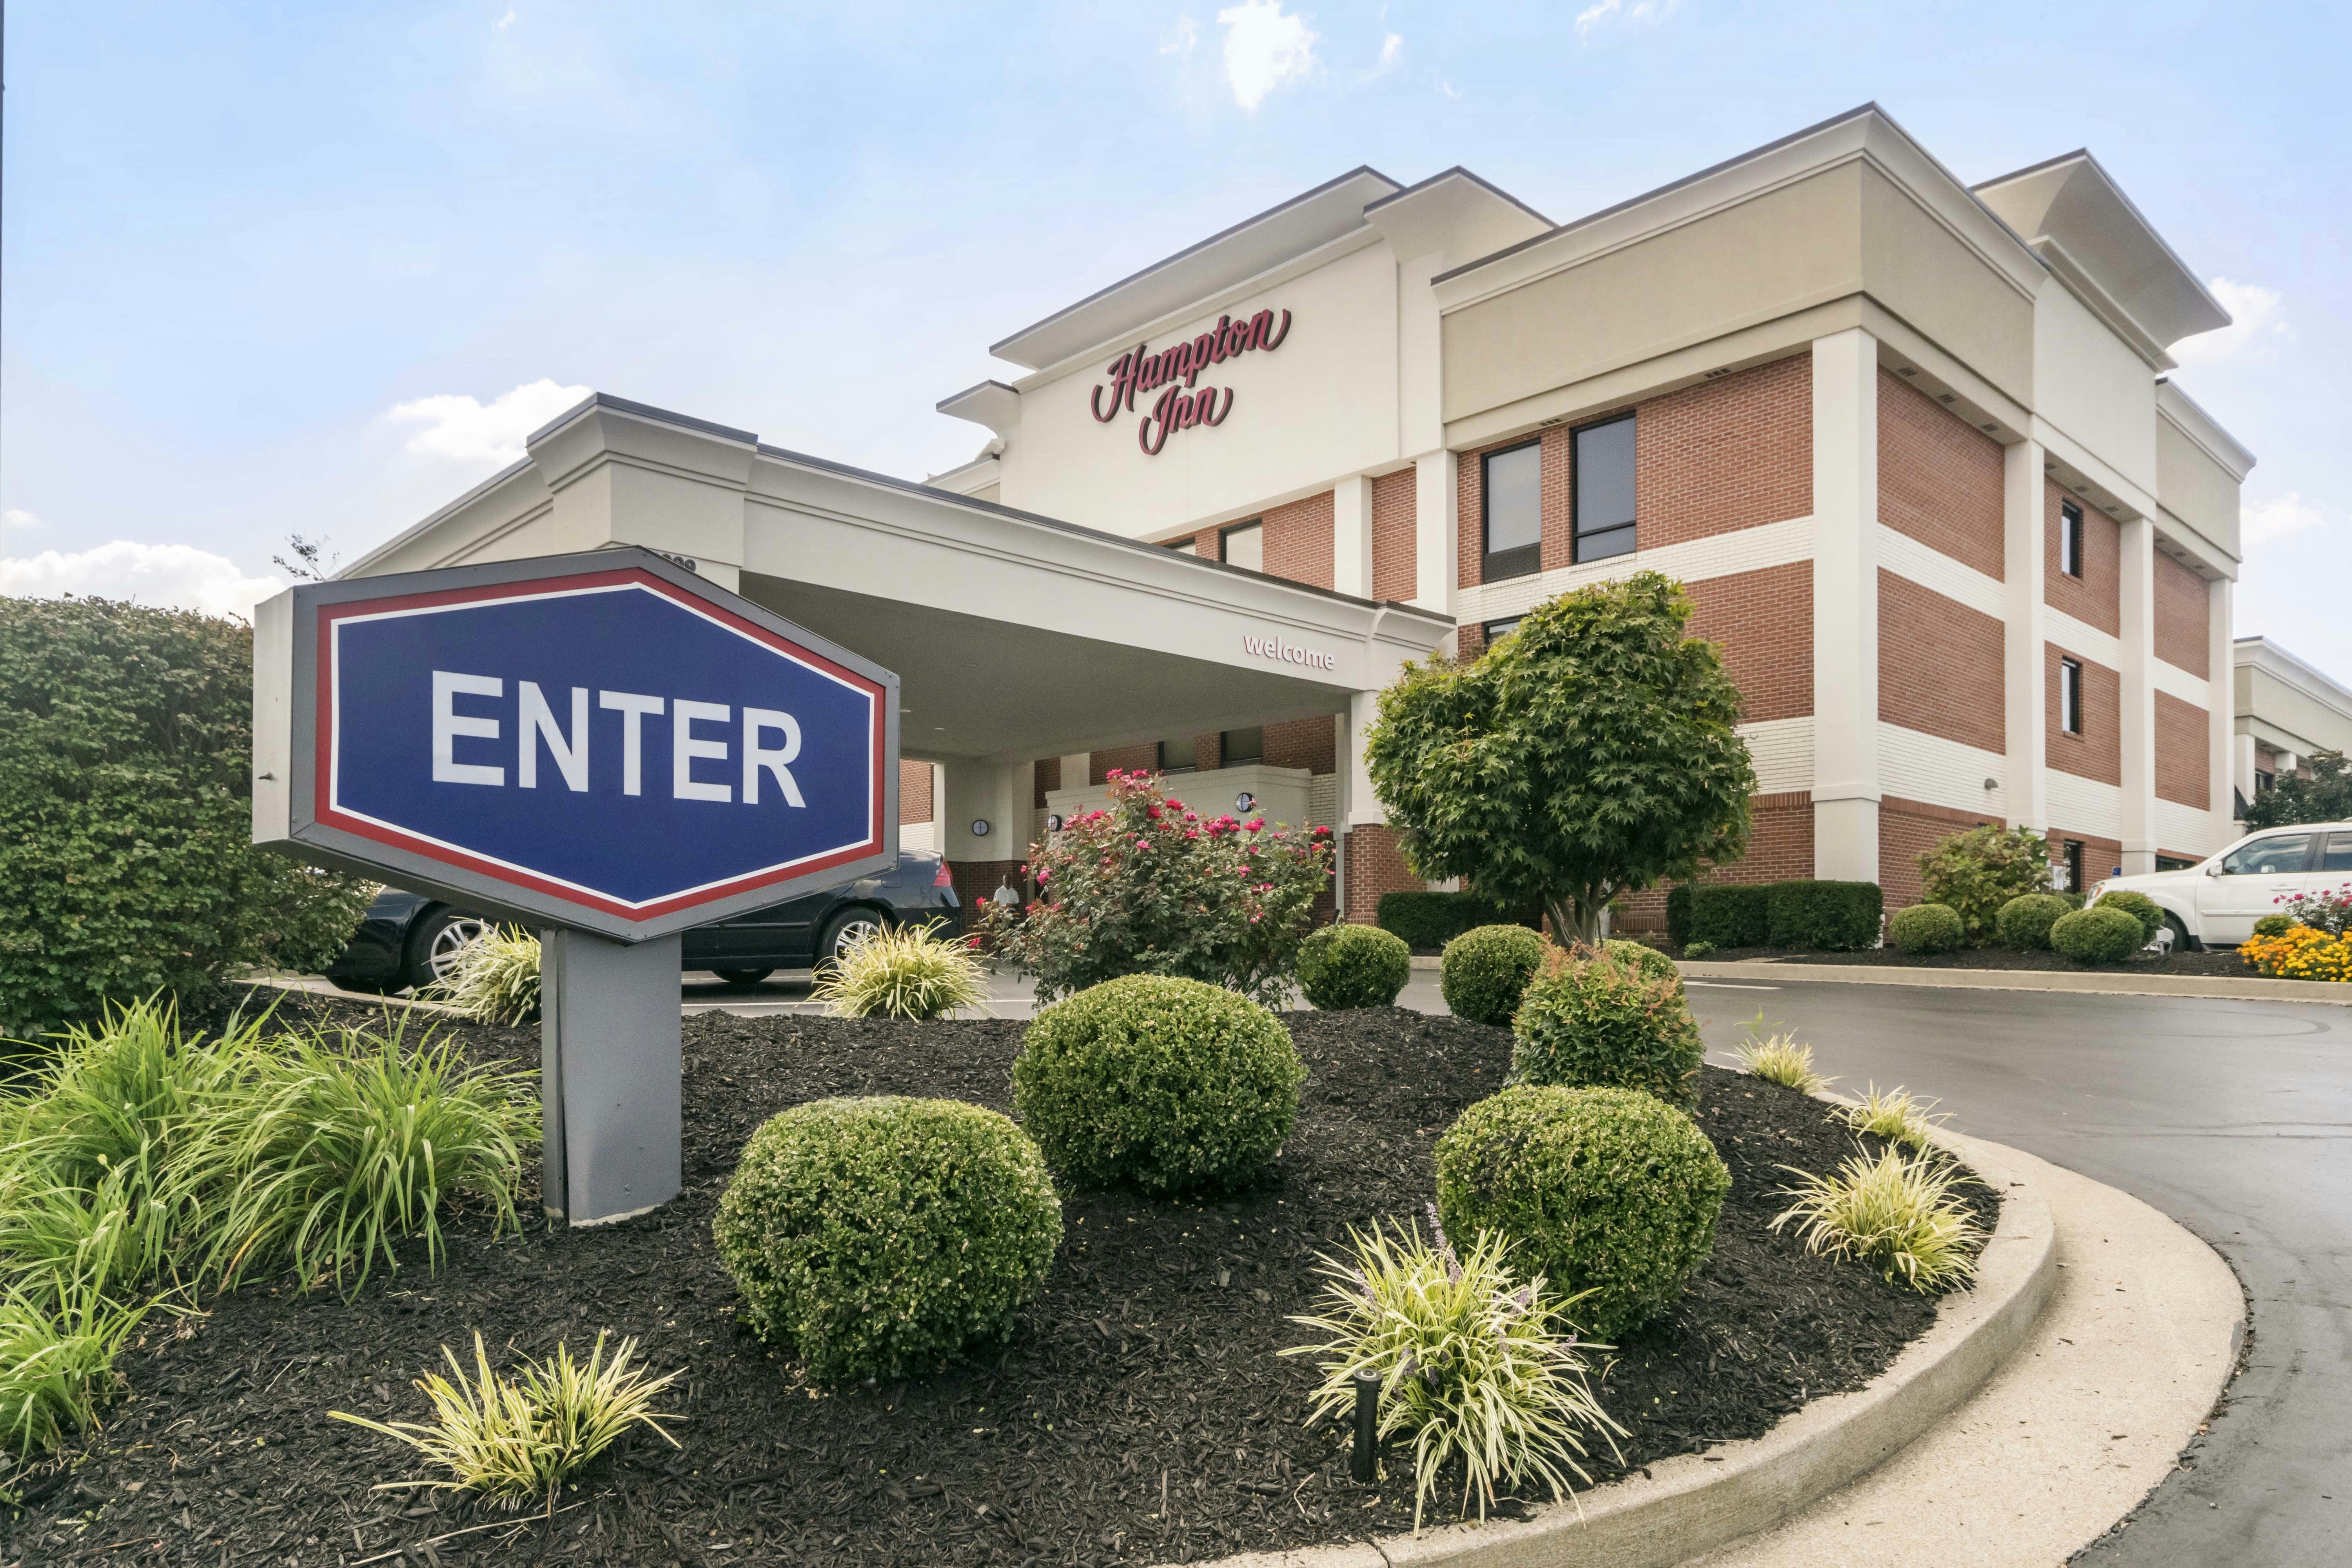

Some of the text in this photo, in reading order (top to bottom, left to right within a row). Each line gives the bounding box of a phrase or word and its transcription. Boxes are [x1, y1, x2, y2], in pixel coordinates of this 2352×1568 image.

[1091, 309, 1291, 423] Hampton
[1139, 385, 1233, 455] Inn
[1243, 635, 1334, 670] welcome
[432, 670, 806, 808] ENTER
